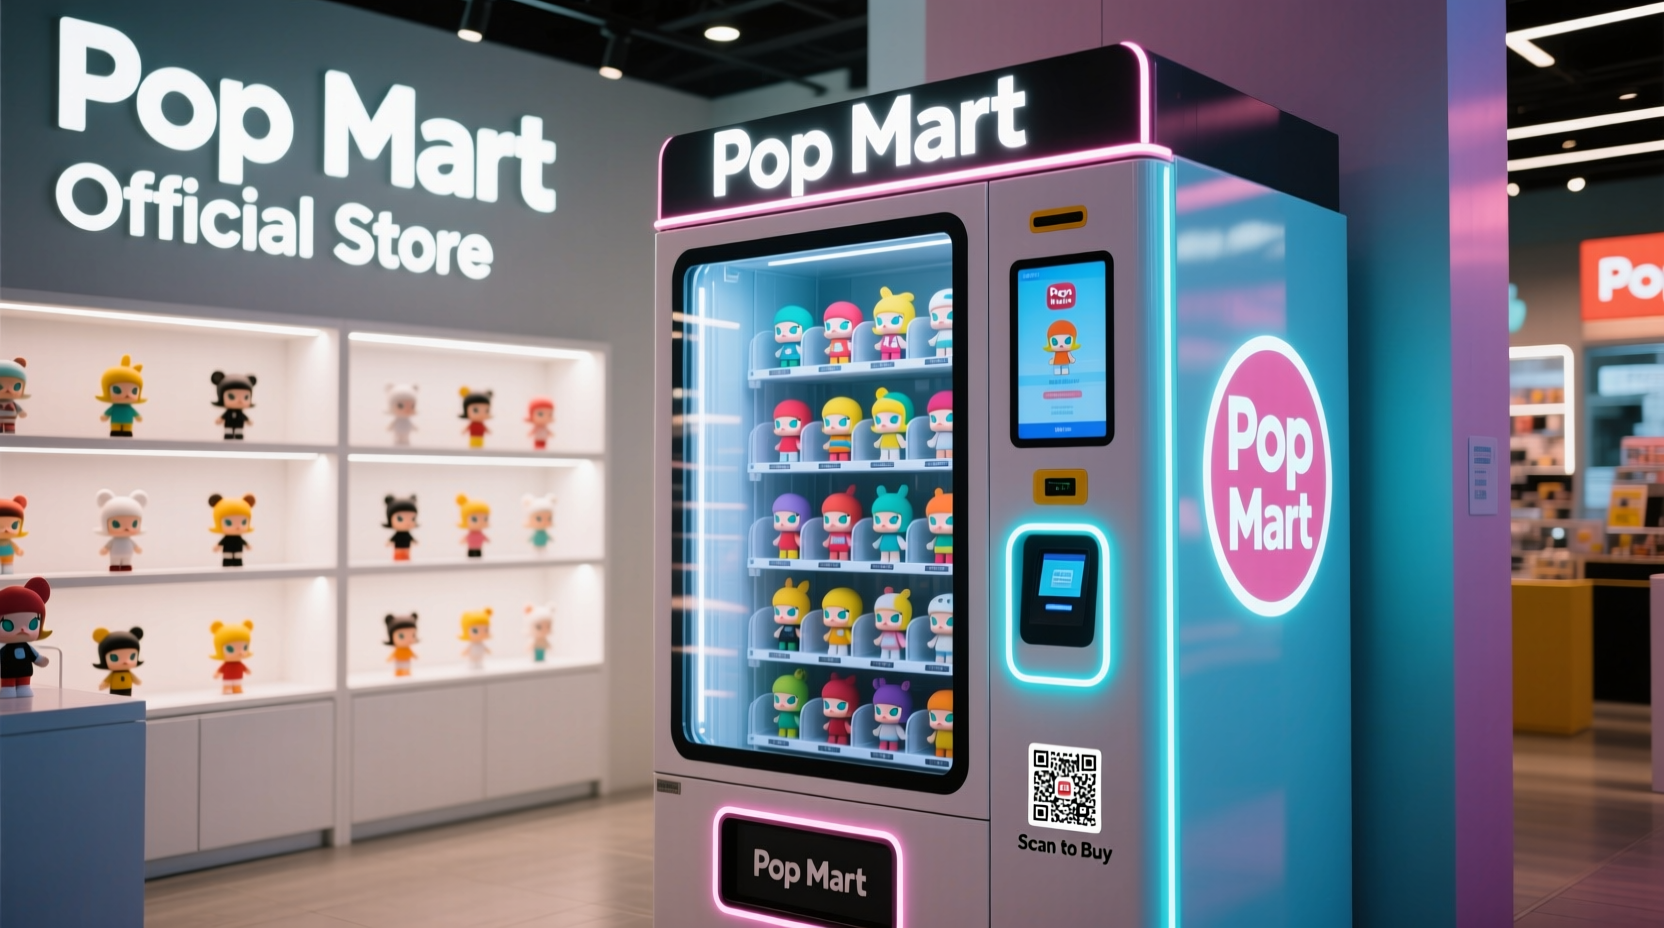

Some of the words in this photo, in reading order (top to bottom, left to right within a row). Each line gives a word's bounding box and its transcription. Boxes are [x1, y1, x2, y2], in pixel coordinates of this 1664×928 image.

[57, 16, 294, 185] Pop
[323, 69, 557, 213] Mart
[713, 128, 833, 198] Pop
[851, 74, 1028, 174] Mart
[55, 162, 314, 259] Official
[333, 202, 494, 280] Store
[1597, 255, 1664, 303] Po
[1228, 395, 1314, 491] Pop
[1229, 487, 1313, 551] Mart
[753, 848, 801, 890] Pop
[806, 858, 867, 897] Mart
[1017, 833, 1056, 854] Scan
[1060, 839, 1077, 857] to
[1080, 841, 1113, 866] Buy
